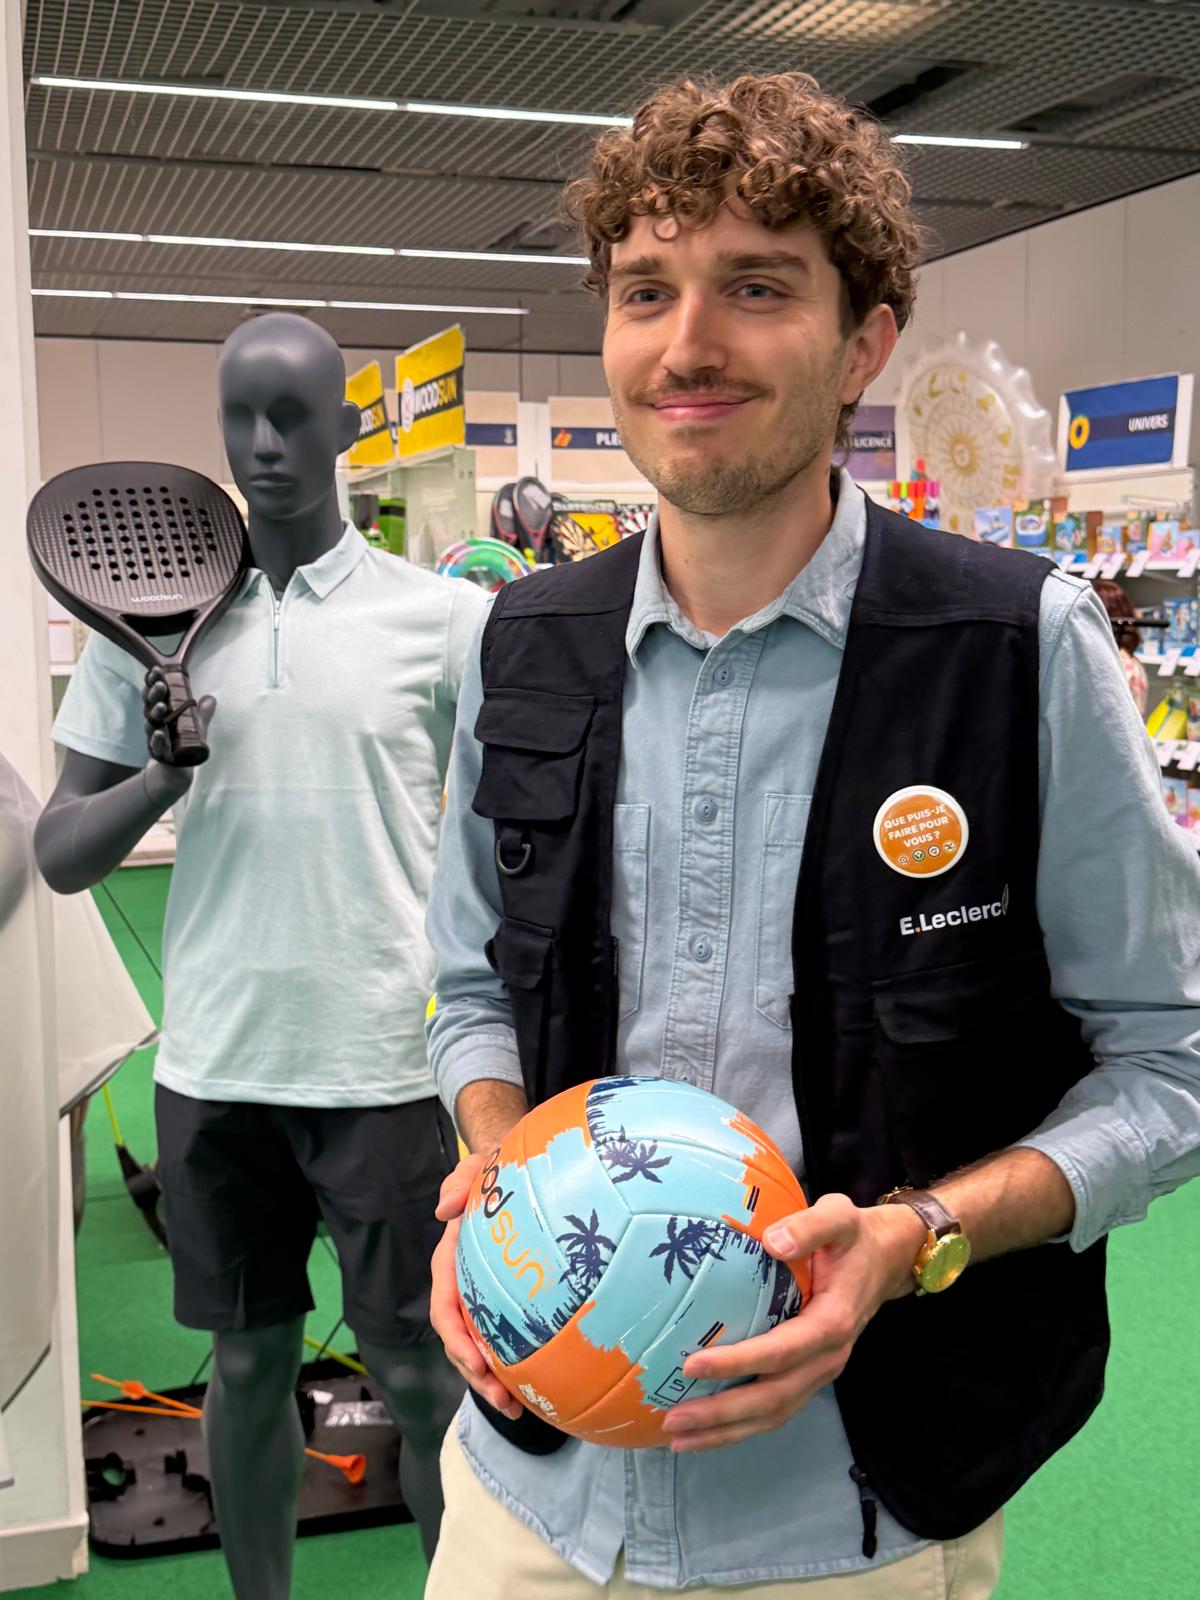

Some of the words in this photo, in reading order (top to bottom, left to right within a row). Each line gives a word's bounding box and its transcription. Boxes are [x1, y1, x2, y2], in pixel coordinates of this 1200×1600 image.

[413, 376, 457, 415] WOODSUN
[1128, 413, 1169, 432] UNIVERS
[853, 436, 892, 449] LICENCE
[131, 593, 183, 603] woodsun
[884, 816, 906, 830] QUE
[907, 804, 947, 823] PUIS-JE
[888, 824, 918, 840] FAIRE
[919, 816, 950, 834] POUR
[903, 833, 933, 848] VOUS
[899, 901, 1002, 936] E.Leclerc
